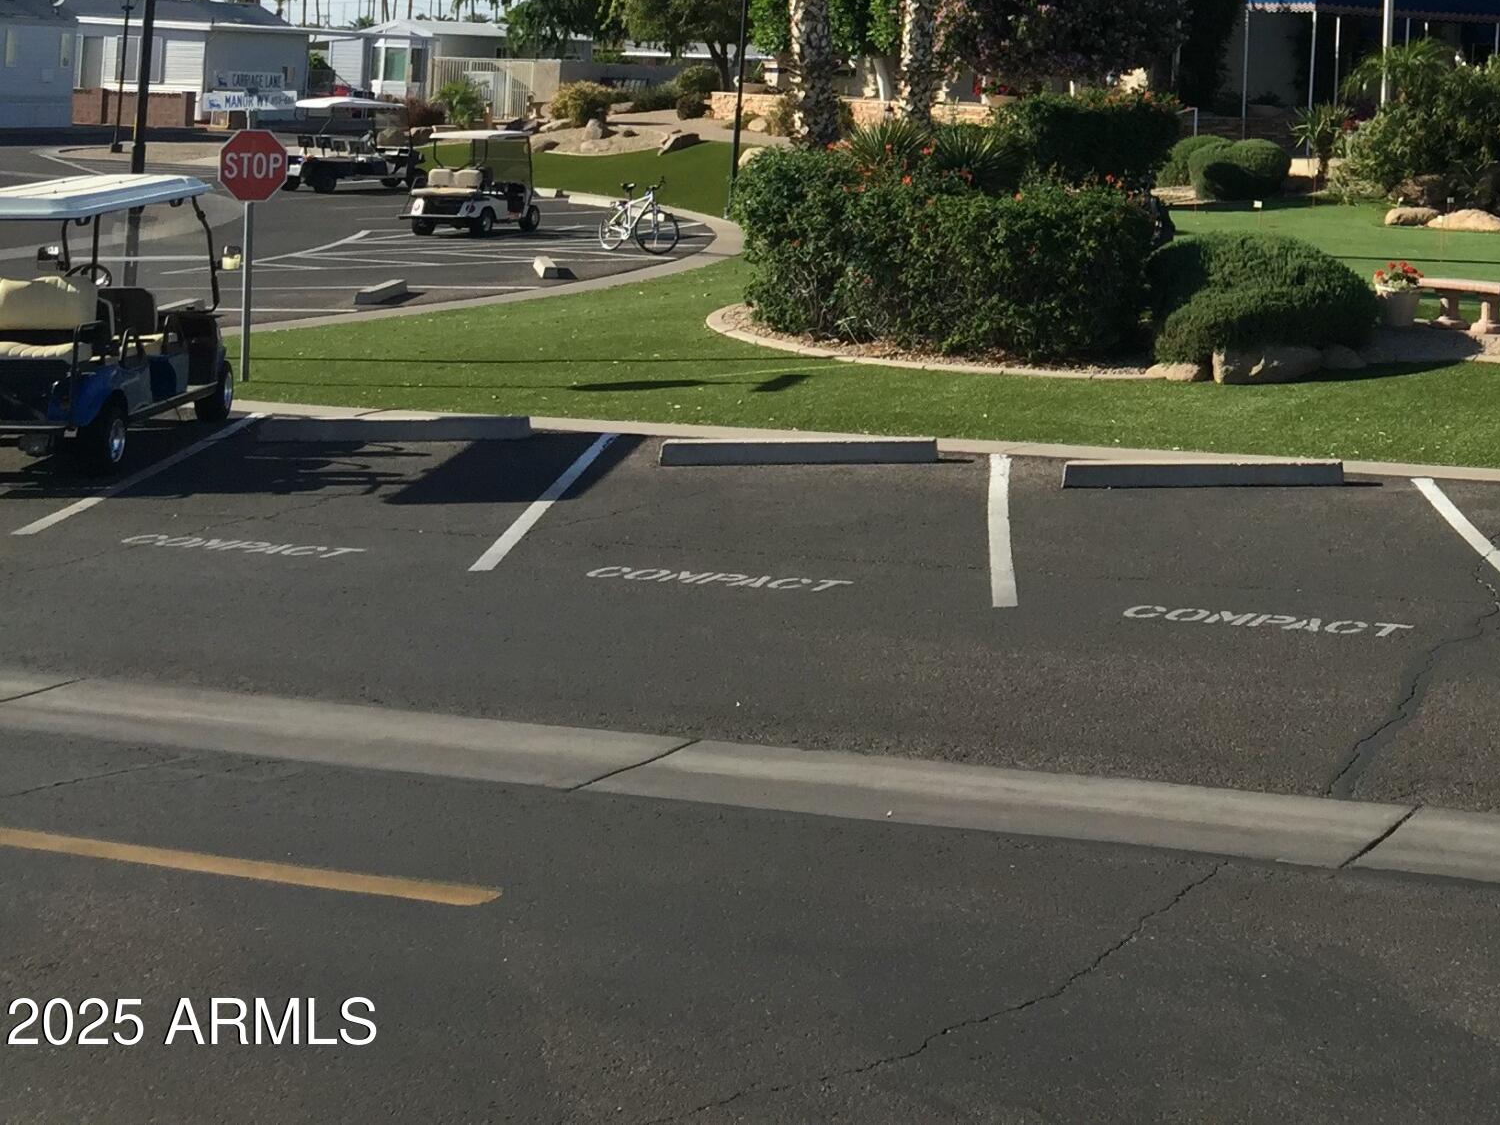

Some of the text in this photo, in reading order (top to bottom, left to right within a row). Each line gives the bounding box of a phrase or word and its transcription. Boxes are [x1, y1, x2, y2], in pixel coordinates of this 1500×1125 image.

[231, 73, 282, 89] CARRIAGE LANE
[224, 94, 254, 108] MANOR
[257, 93, 270, 107] WY
[224, 152, 283, 179] STOP
[121, 533, 366, 558] COMPACT
[586, 565, 855, 591] COMPACT
[1123, 605, 1414, 638] COMPACT
